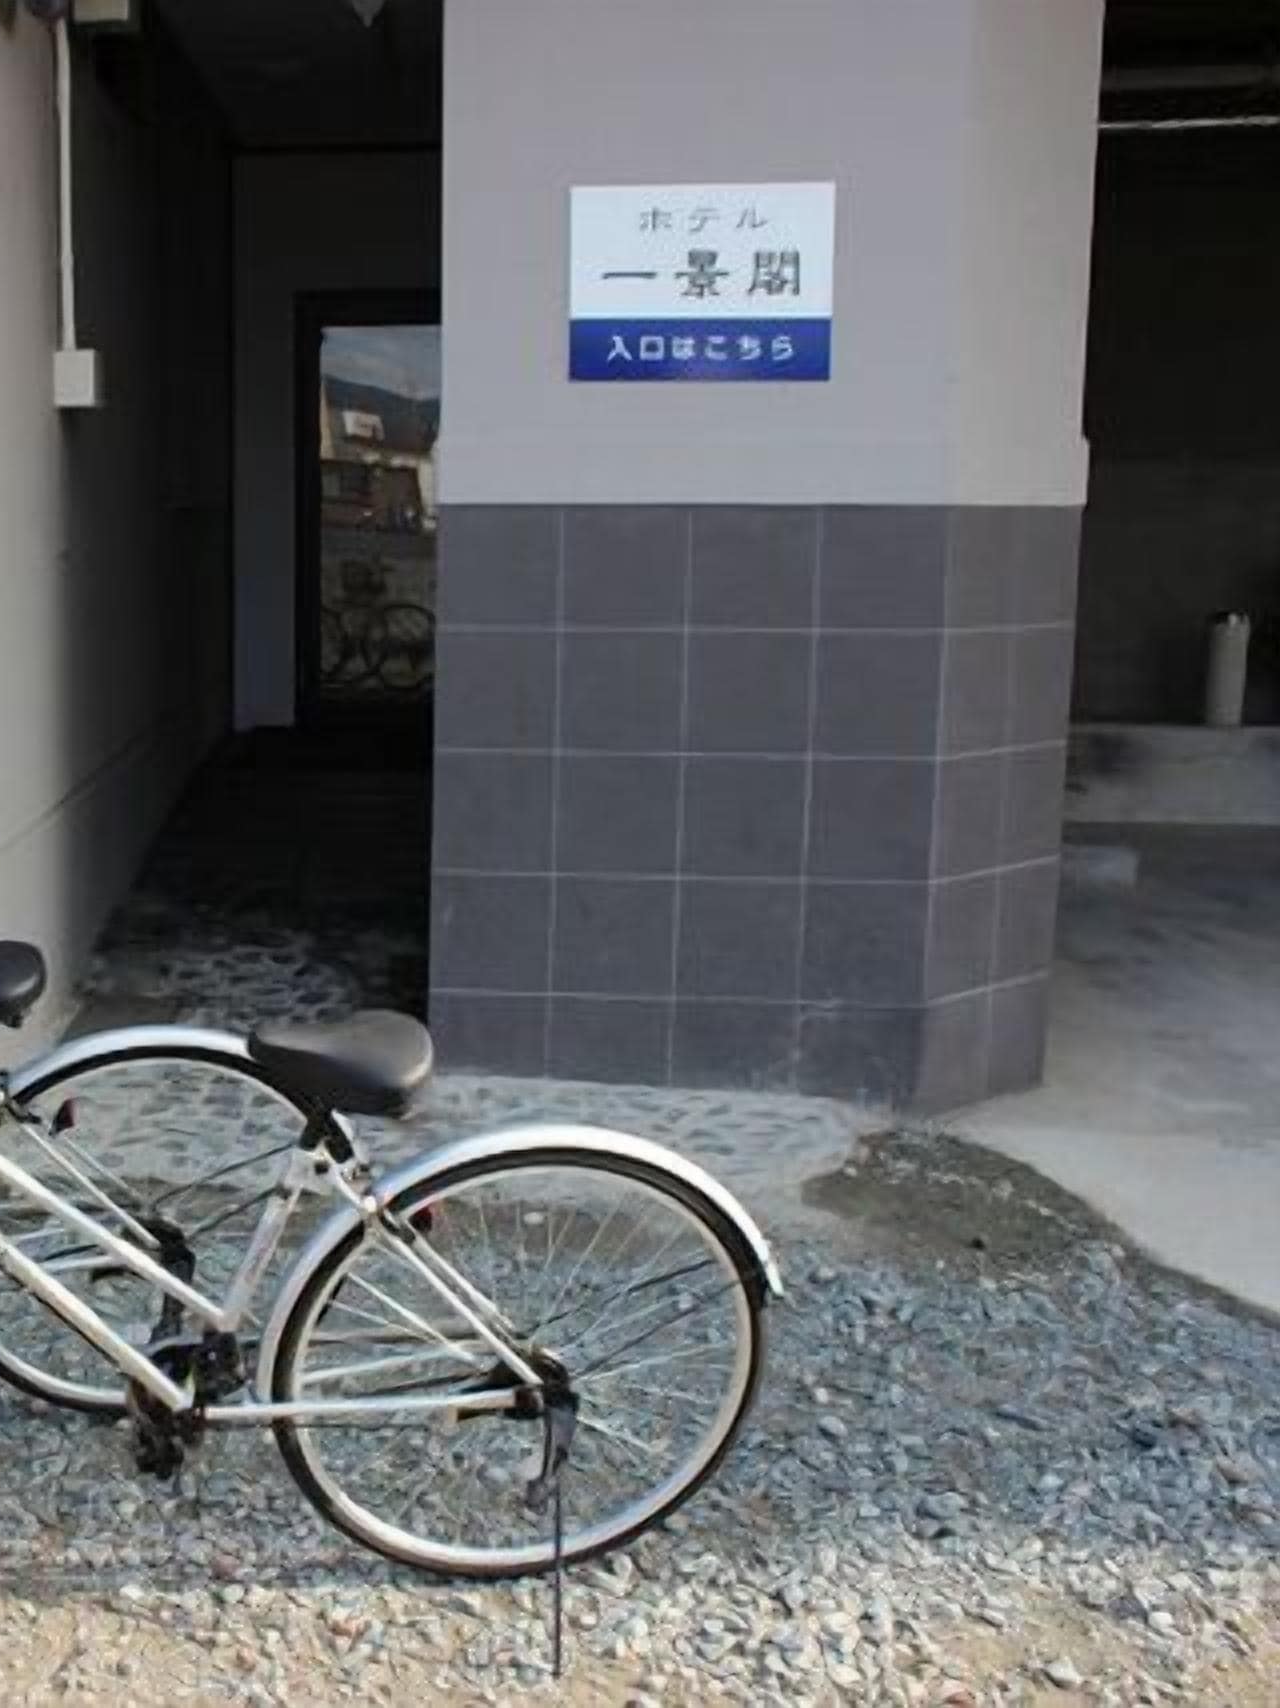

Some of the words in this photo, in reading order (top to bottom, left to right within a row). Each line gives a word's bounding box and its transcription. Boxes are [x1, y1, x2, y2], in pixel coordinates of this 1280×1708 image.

[639, 206, 769, 233] ホテル
[606, 334, 795, 362] 入口はこちら
